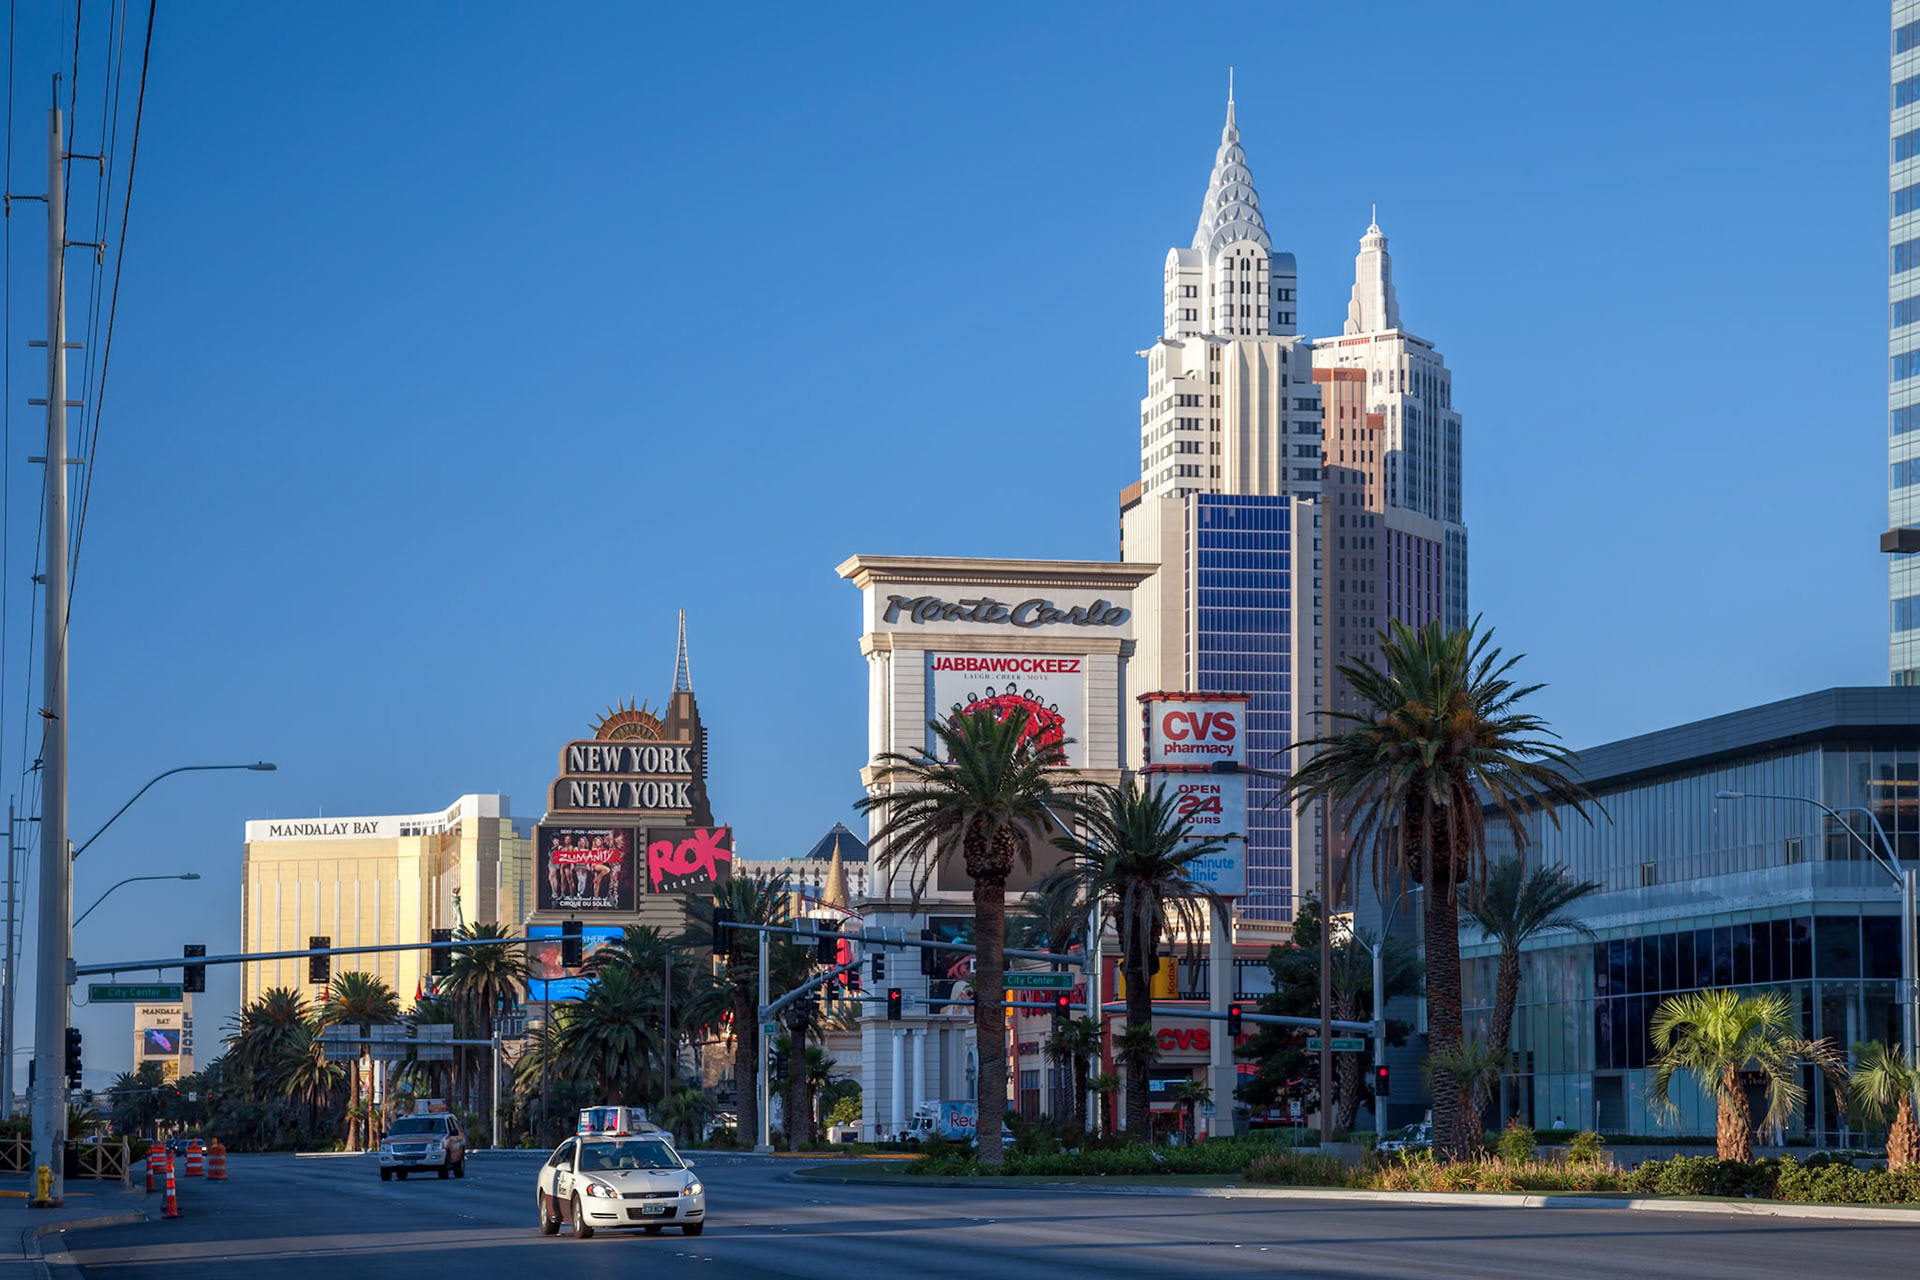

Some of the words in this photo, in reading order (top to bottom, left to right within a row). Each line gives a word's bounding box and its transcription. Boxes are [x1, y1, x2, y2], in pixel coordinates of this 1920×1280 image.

[883, 595, 1011, 624] Monte
[1010, 599, 1131, 628] Carlo
[931, 657, 1081, 673] JABBAWOCKEEZ
[1162, 711, 1236, 742] CVS
[1164, 742, 1235, 756] pharmacy
[569, 746, 623, 772] NEW
[629, 747, 692, 773] YORK
[569, 781, 623, 807] NEW
[629, 782, 692, 808] YORK
[1178, 784, 1221, 794] OPEN
[1178, 795, 1223, 815] 24
[269, 822, 349, 836] MANDALAY
[353, 821, 379, 834] BAY
[559, 850, 614, 863] ZUMANITY
[648, 828, 732, 893] ROK
[560, 900, 581, 908] CIRQUE
[1008, 976, 1025, 986] City
[1027, 976, 1054, 985] Center
[108, 987, 127, 998] City
[129, 987, 160, 997] Center
[182, 1012, 194, 1055] LUXOR
[1157, 1028, 1210, 1051] CVS
